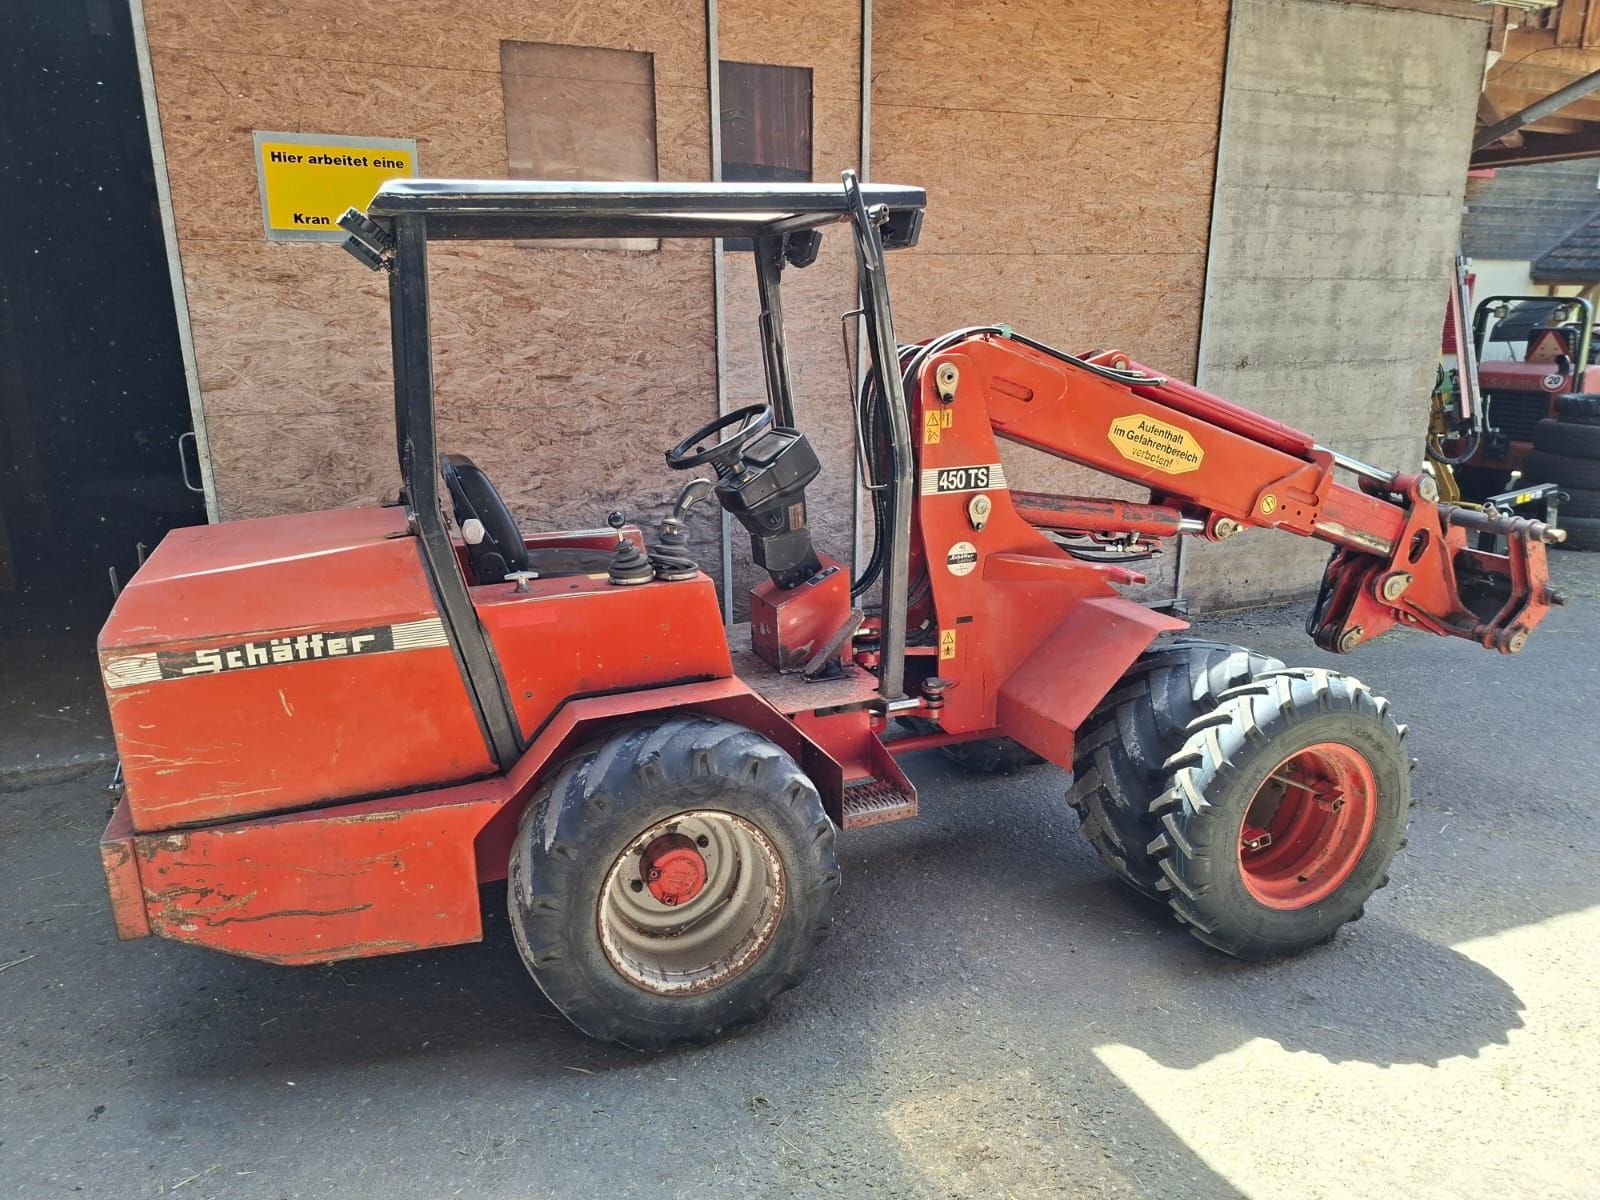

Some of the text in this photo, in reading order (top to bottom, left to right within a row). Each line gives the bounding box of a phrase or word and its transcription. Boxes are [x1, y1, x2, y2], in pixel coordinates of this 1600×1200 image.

[271, 151, 404, 169] Hier arbeitet eine
[293, 213, 330, 225] Kran
[1547, 376, 1560, 385] 20
[1138, 420, 1184, 445] Aufenthalt
[1113, 425, 1198, 464] im Gefahrenbereich
[1131, 447, 1174, 469] verboten!
[939, 468, 988, 490] 450 TS
[182, 633, 375, 675] Schäffer
